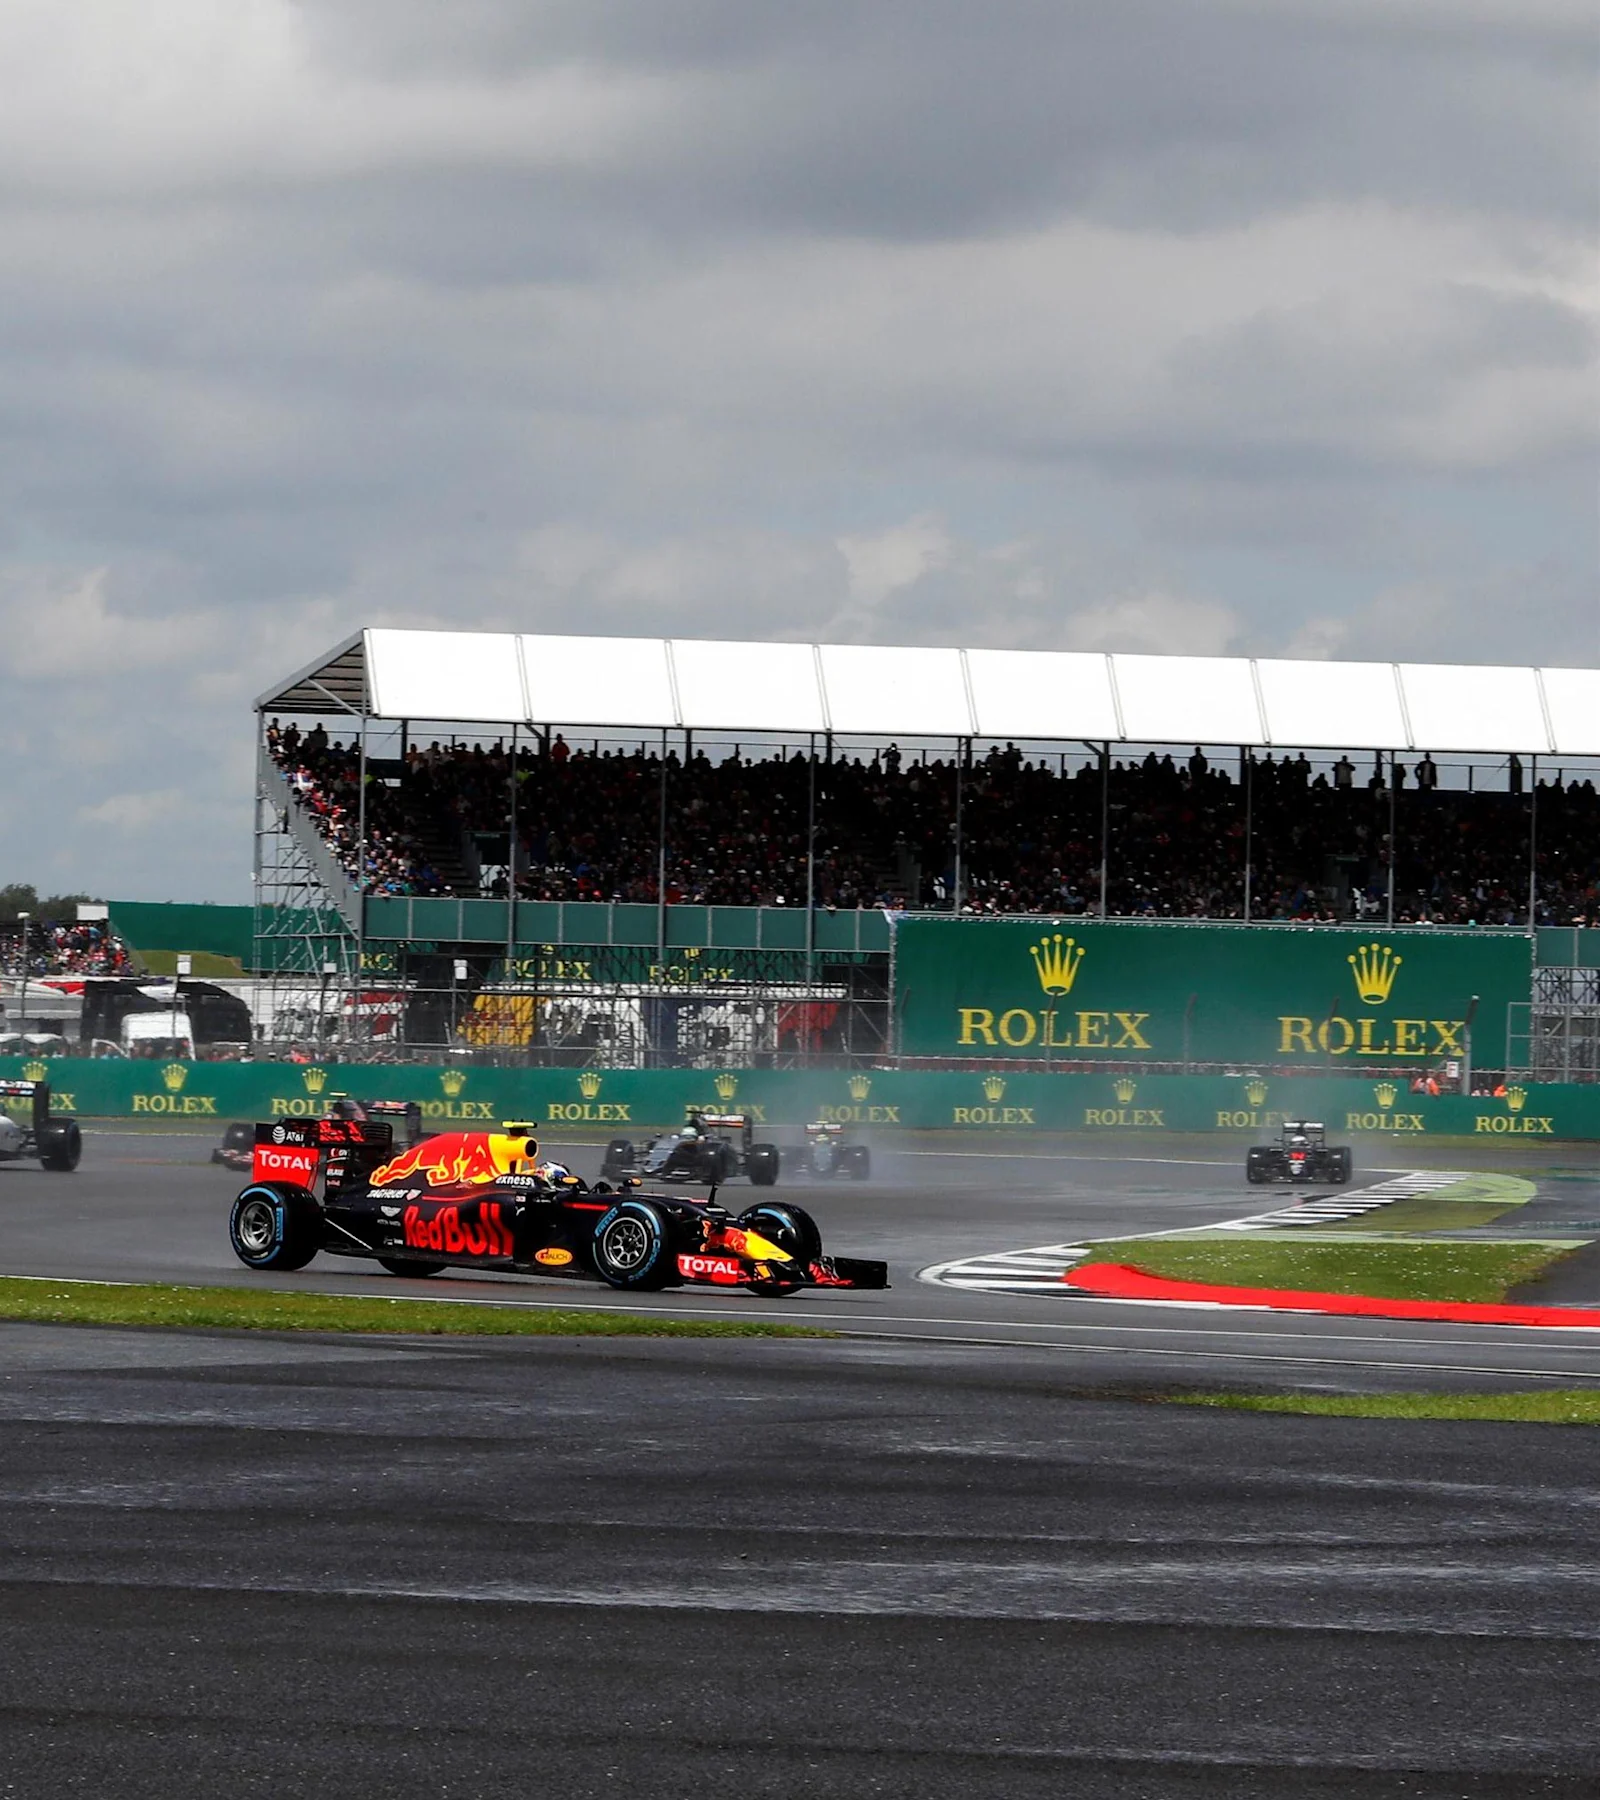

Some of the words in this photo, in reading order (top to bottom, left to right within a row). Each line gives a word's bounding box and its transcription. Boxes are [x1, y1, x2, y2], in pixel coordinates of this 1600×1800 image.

[957, 1008, 1152, 1050] ROLEX
[1278, 1016, 1466, 1057] ROLEX
[132, 1095, 217, 1114] ROLEX
[271, 1098, 337, 1116] ROLE
[547, 1103, 632, 1122] ROLEX
[820, 1106, 900, 1123] ROLEX
[953, 1107, 1035, 1124] ROLEX
[1084, 1109, 1164, 1126] ROLEX
[1346, 1113, 1425, 1131] ROLEX
[1475, 1116, 1554, 1134] ROLEX
[258, 1150, 312, 1171] TOTAL
[679, 1255, 738, 1275] TOTAL
